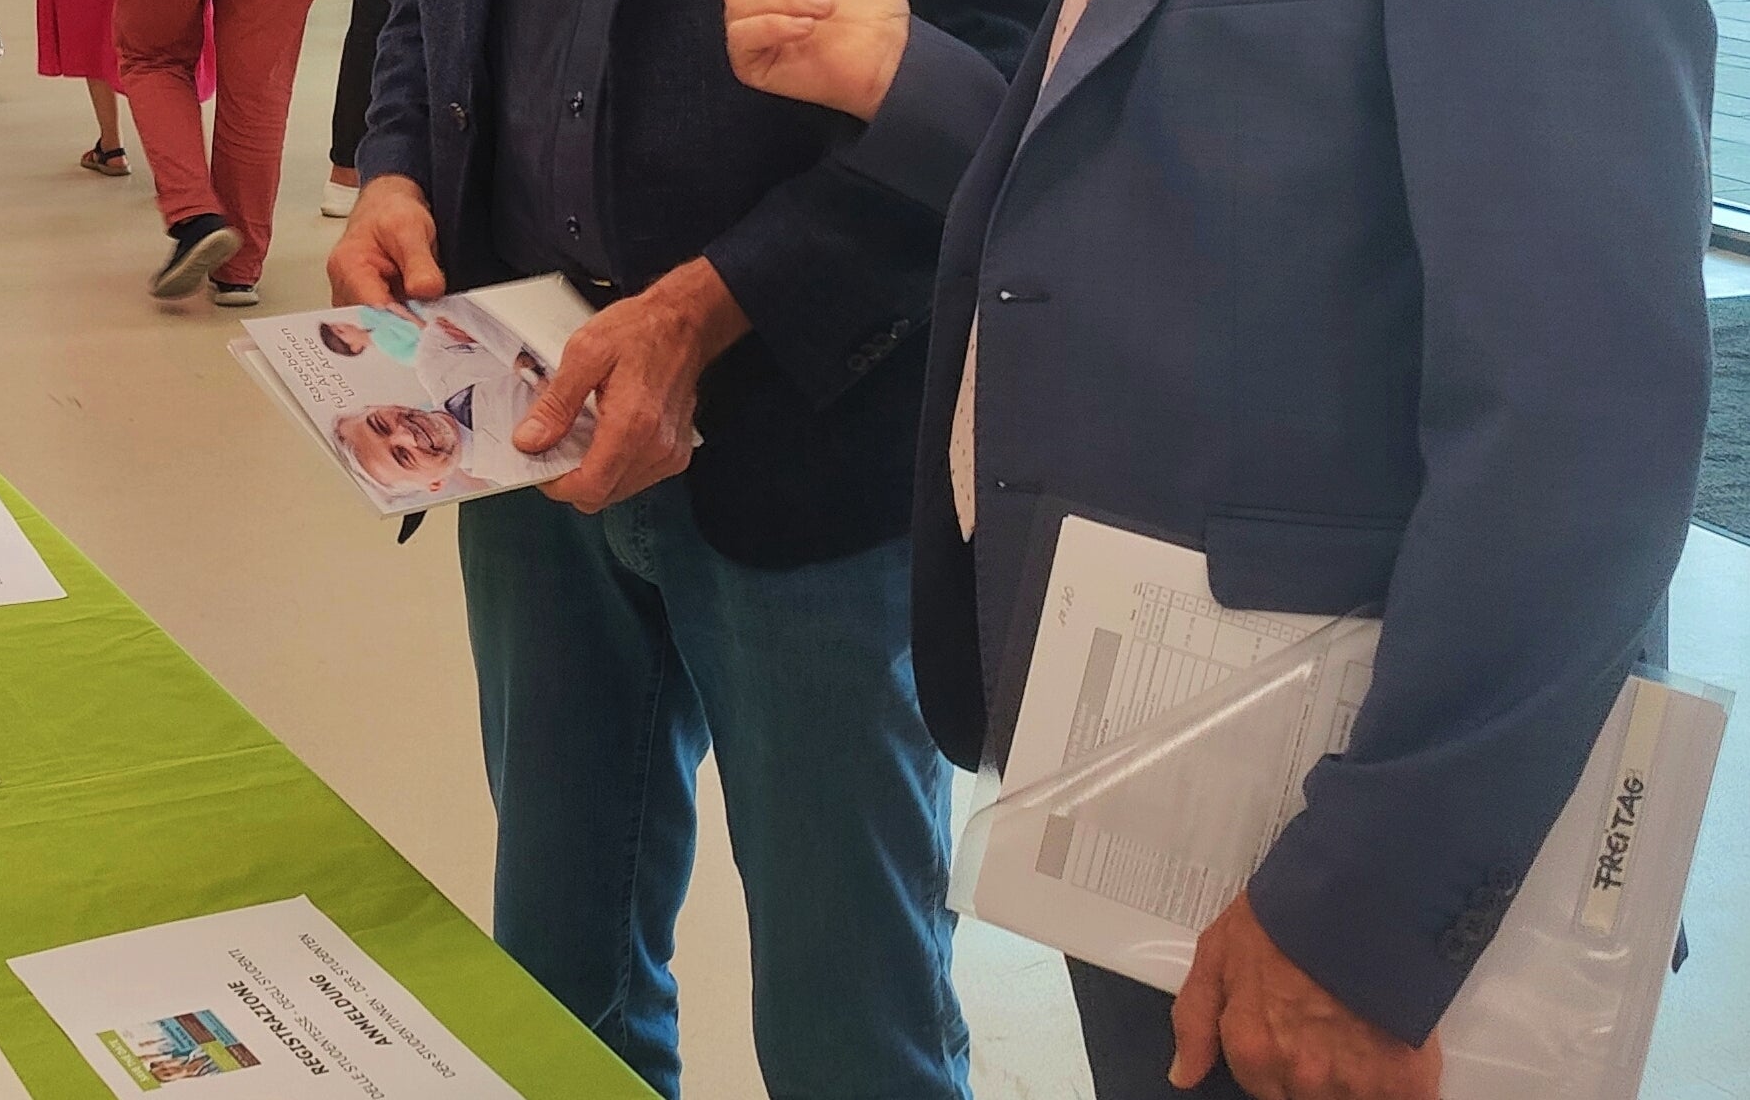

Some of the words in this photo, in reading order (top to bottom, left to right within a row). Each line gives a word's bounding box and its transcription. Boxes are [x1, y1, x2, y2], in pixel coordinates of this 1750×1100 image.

[277, 345, 325, 403] Ratgeber
[226, 979, 330, 1076] REGISTRAZIONE
[308, 973, 394, 1047] ANMELDUNG
